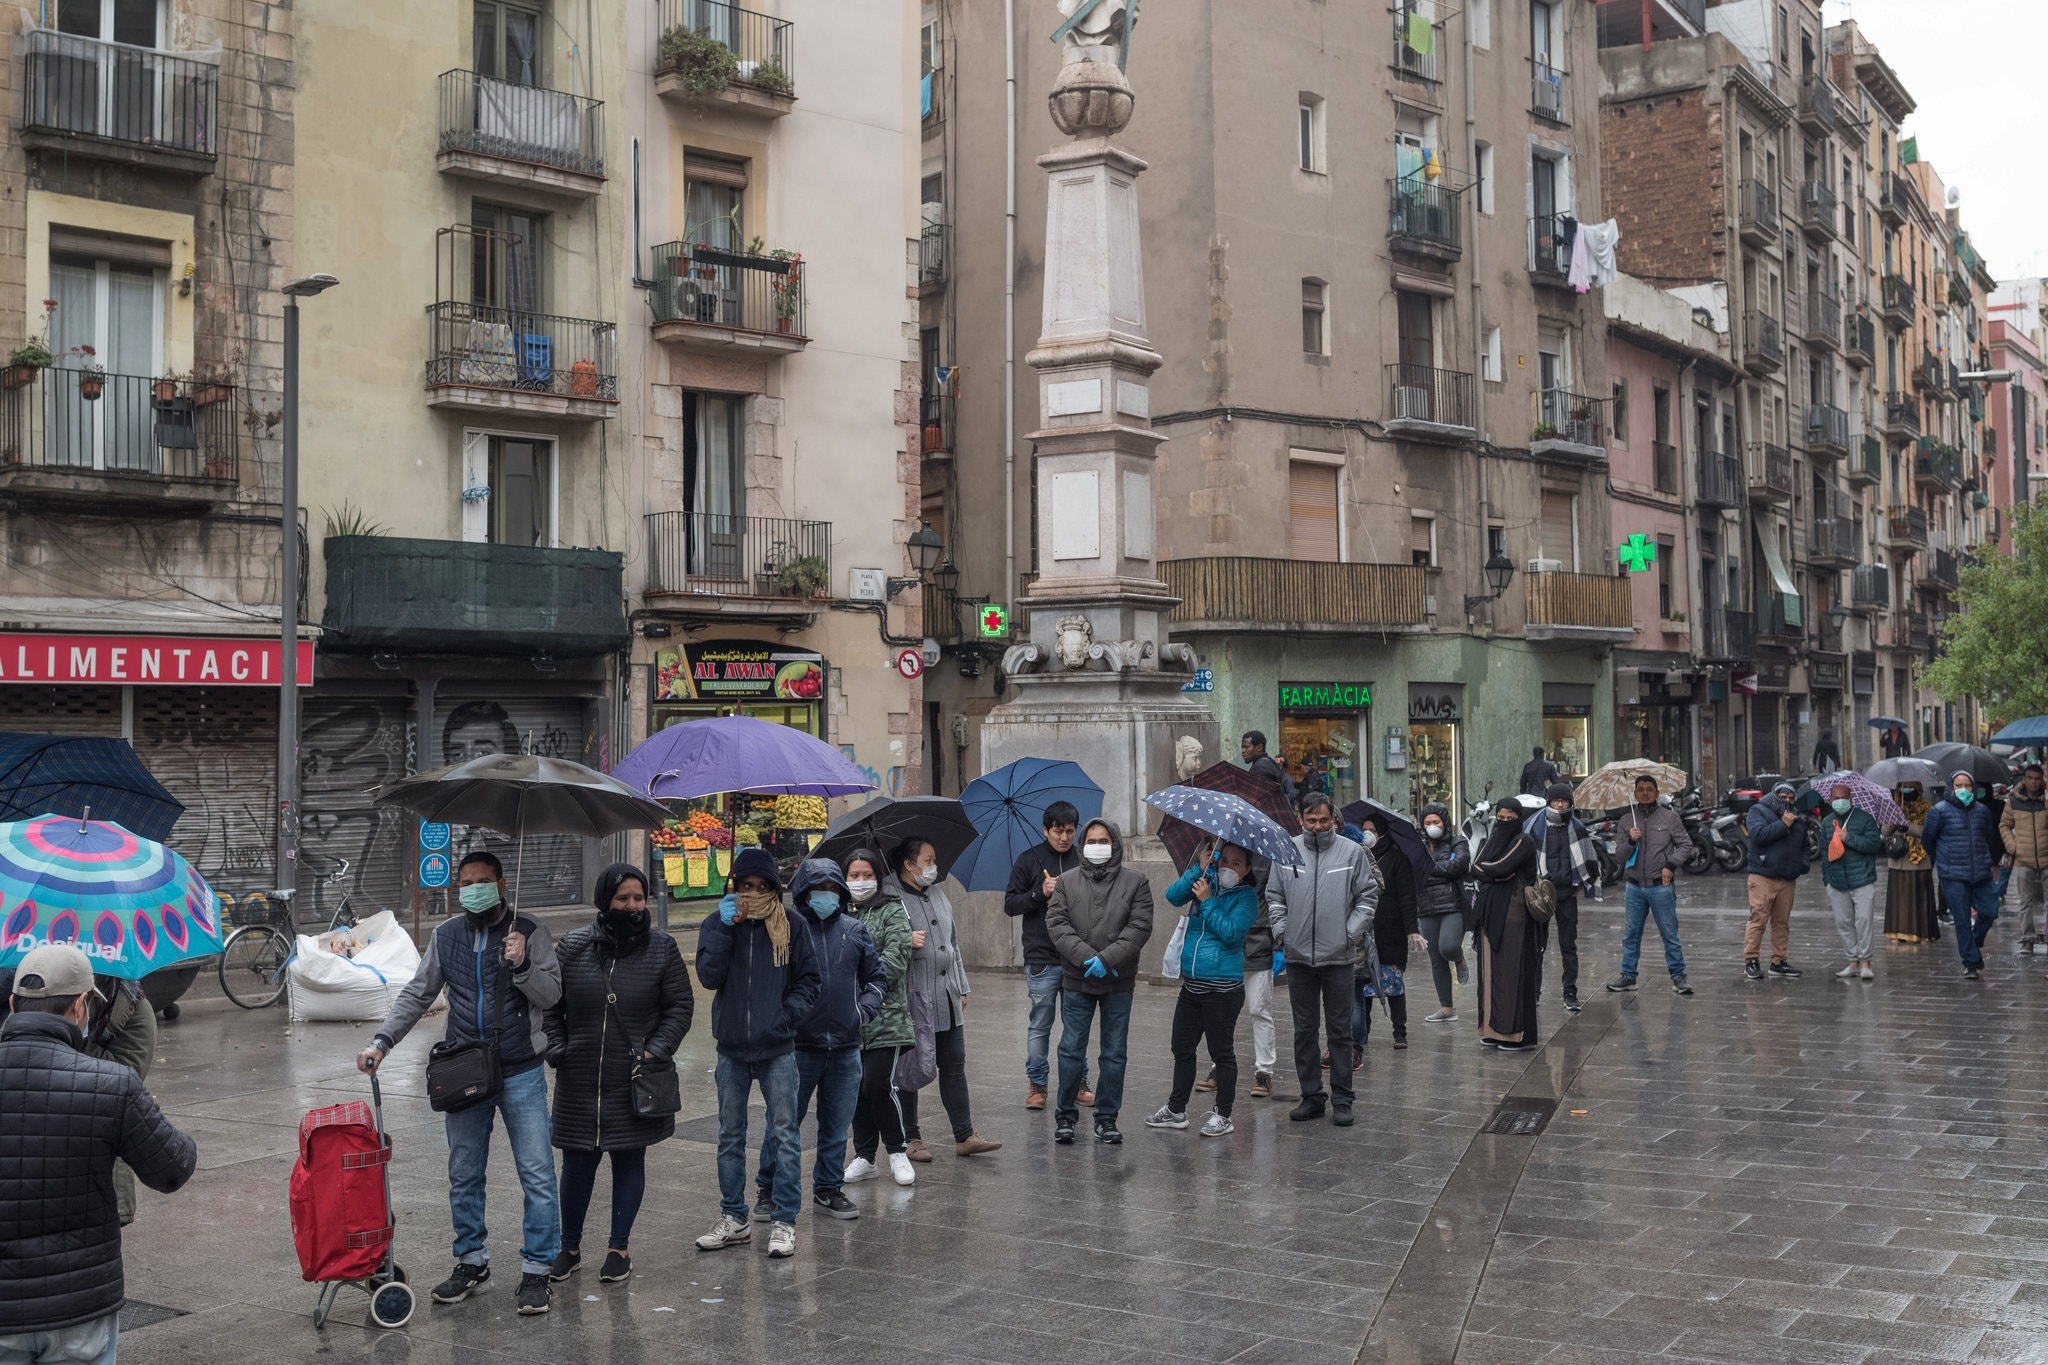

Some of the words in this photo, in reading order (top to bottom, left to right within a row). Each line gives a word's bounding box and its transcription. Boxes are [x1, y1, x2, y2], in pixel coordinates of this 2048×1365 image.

[0, 645, 298, 680] LIMENTACI
[694, 662, 719, 679] AL
[724, 662, 776, 680] AWAN
[1281, 683, 1372, 706] FARMÀCIA
